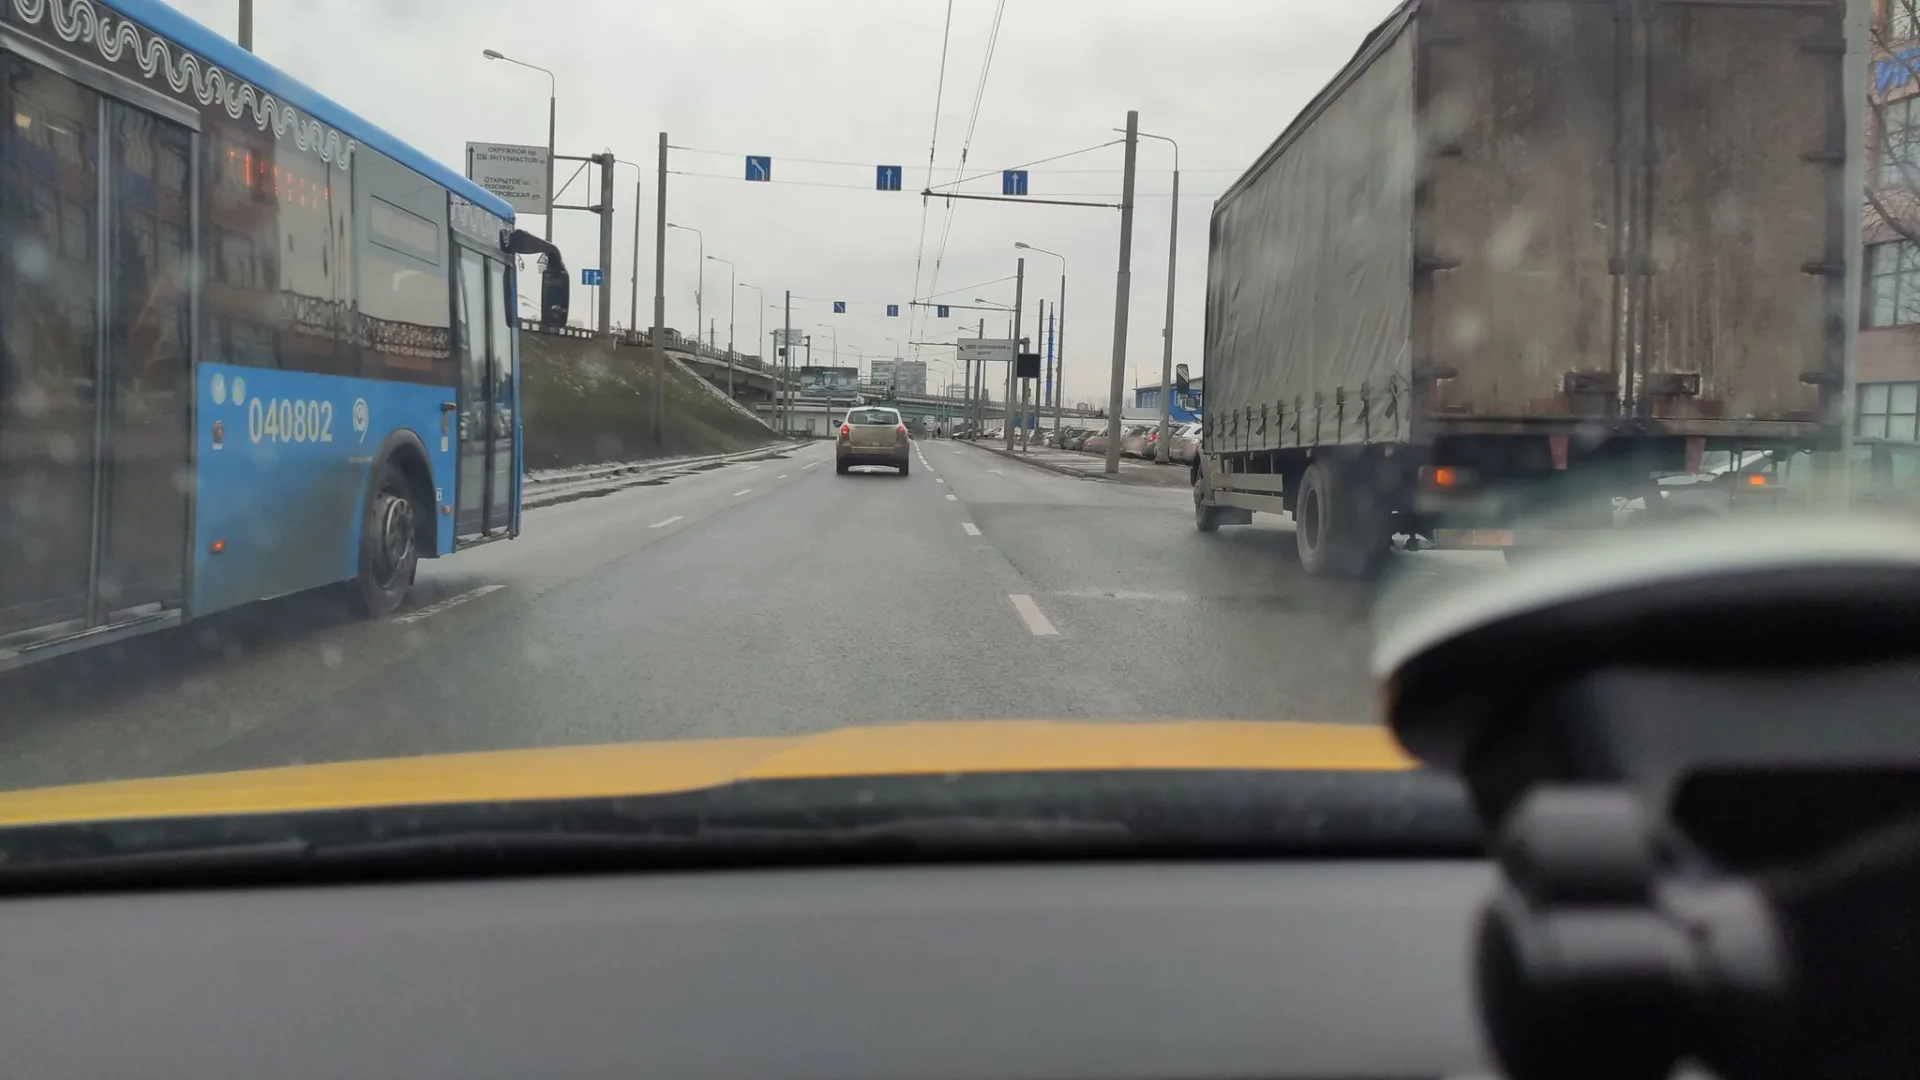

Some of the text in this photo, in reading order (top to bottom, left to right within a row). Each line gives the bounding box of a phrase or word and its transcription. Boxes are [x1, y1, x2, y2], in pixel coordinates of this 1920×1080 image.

[488, 155, 539, 163] ЭНТУЗИАСТОВ
[484, 176, 521, 185] ОТКРЫТОЕ
[249, 397, 333, 443] 040802
